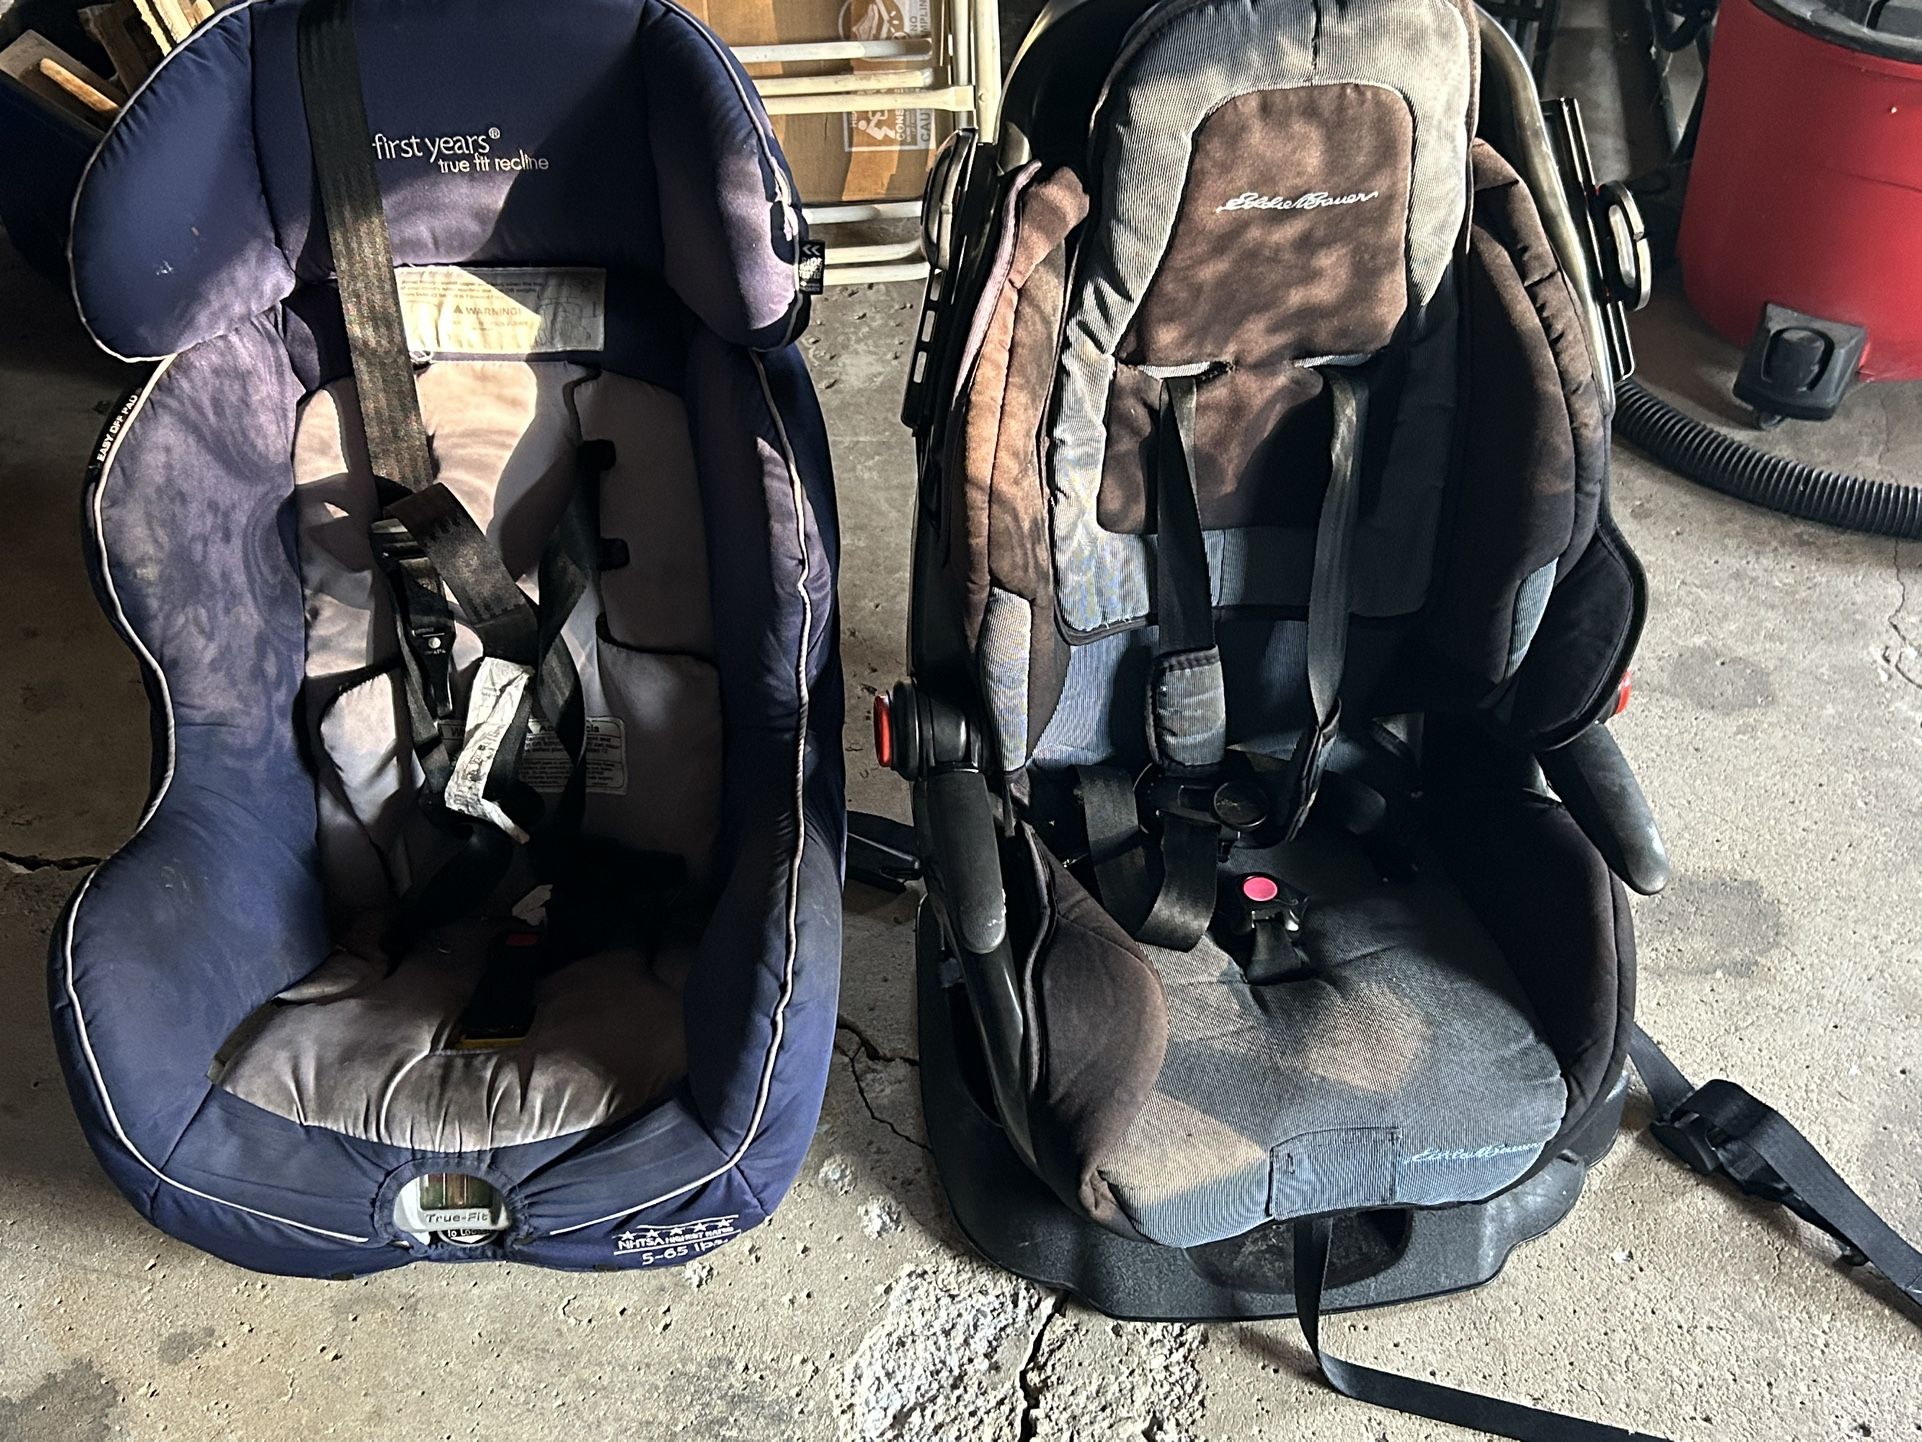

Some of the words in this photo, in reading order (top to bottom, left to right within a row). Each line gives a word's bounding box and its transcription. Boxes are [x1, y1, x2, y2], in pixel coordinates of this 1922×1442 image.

[371, 133, 423, 160] first
[438, 158, 470, 173] true
[473, 152, 490, 172] fit
[494, 149, 549, 172] recline
[97, 433, 114, 462] EASY
[426, 1212, 488, 1223] True-Fit
[618, 1238, 665, 1250] NHTSA
[641, 1245, 689, 1266] 5-65
